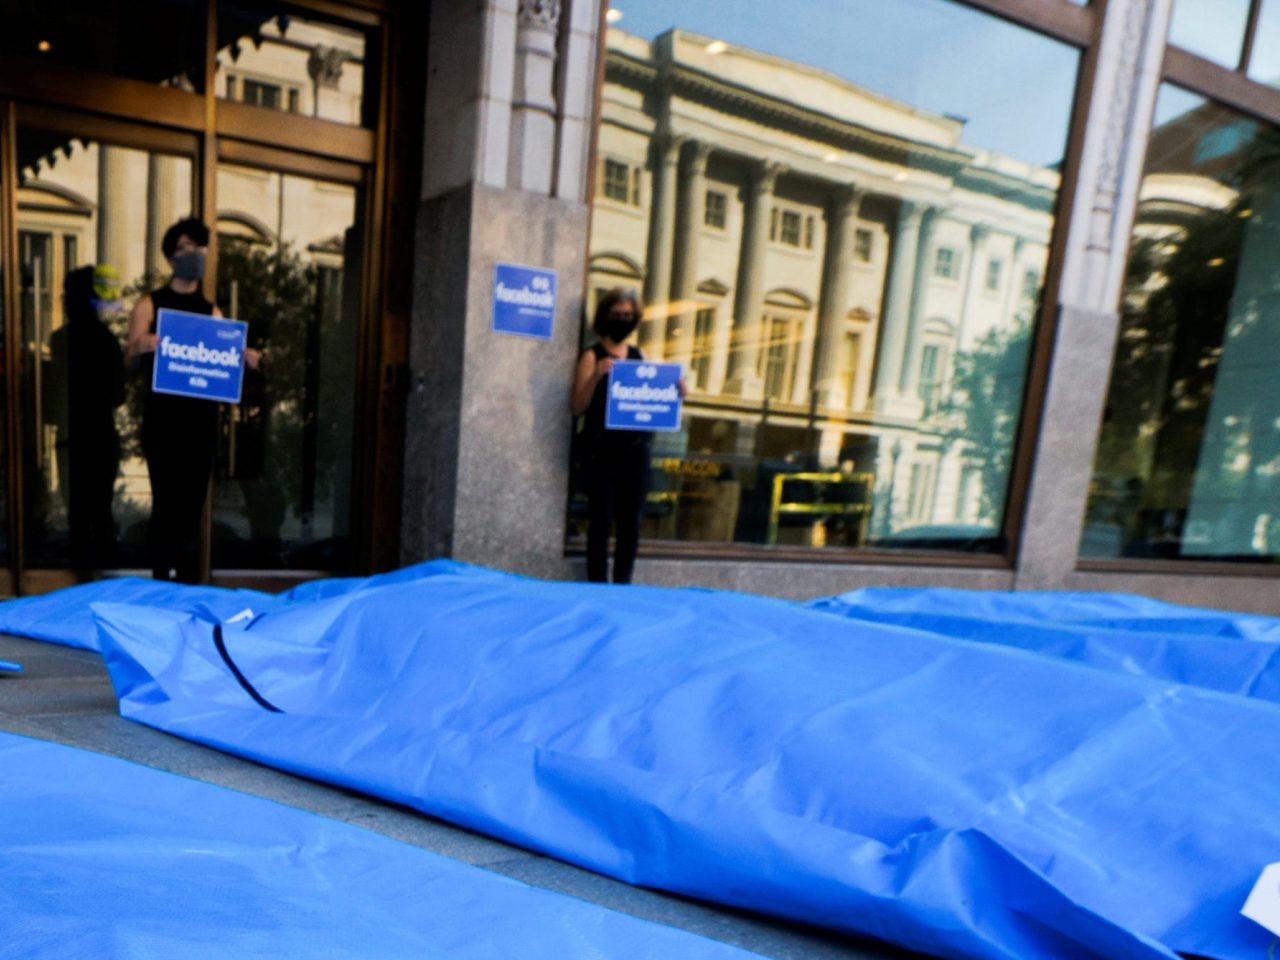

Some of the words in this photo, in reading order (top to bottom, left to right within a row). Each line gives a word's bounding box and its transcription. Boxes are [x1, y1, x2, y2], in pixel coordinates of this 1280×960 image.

[496, 282, 553, 308] facebook
[161, 336, 240, 367] facebook
[612, 381, 678, 402] facebook
